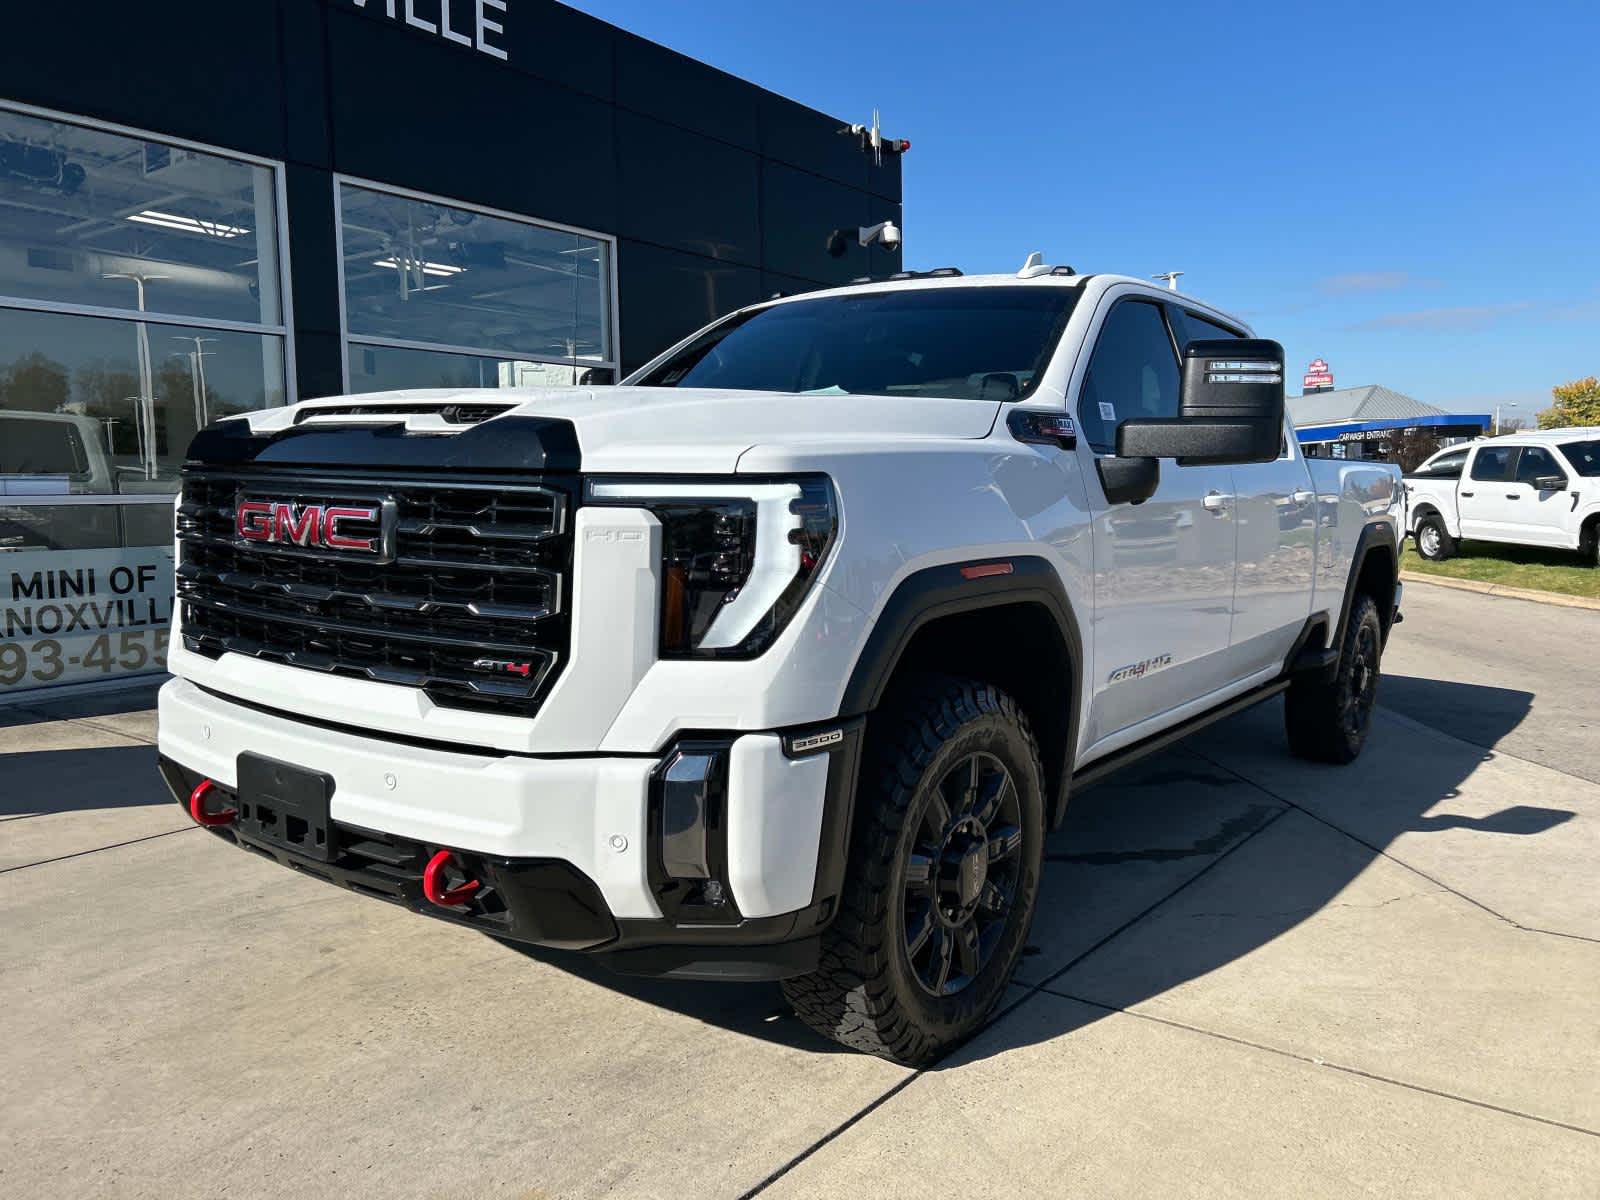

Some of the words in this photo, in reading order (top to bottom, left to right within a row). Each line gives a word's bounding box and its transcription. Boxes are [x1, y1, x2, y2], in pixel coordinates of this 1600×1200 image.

[353, 0, 508, 60] LLE
[1366, 430, 1393, 440] ENTRANC
[237, 502, 379, 552] GMC
[585, 530, 644, 542] HD
[11, 568, 96, 600] MINI
[109, 565, 157, 594] OF
[0, 596, 174, 638] NOXVILL
[794, 733, 840, 748] 3500
